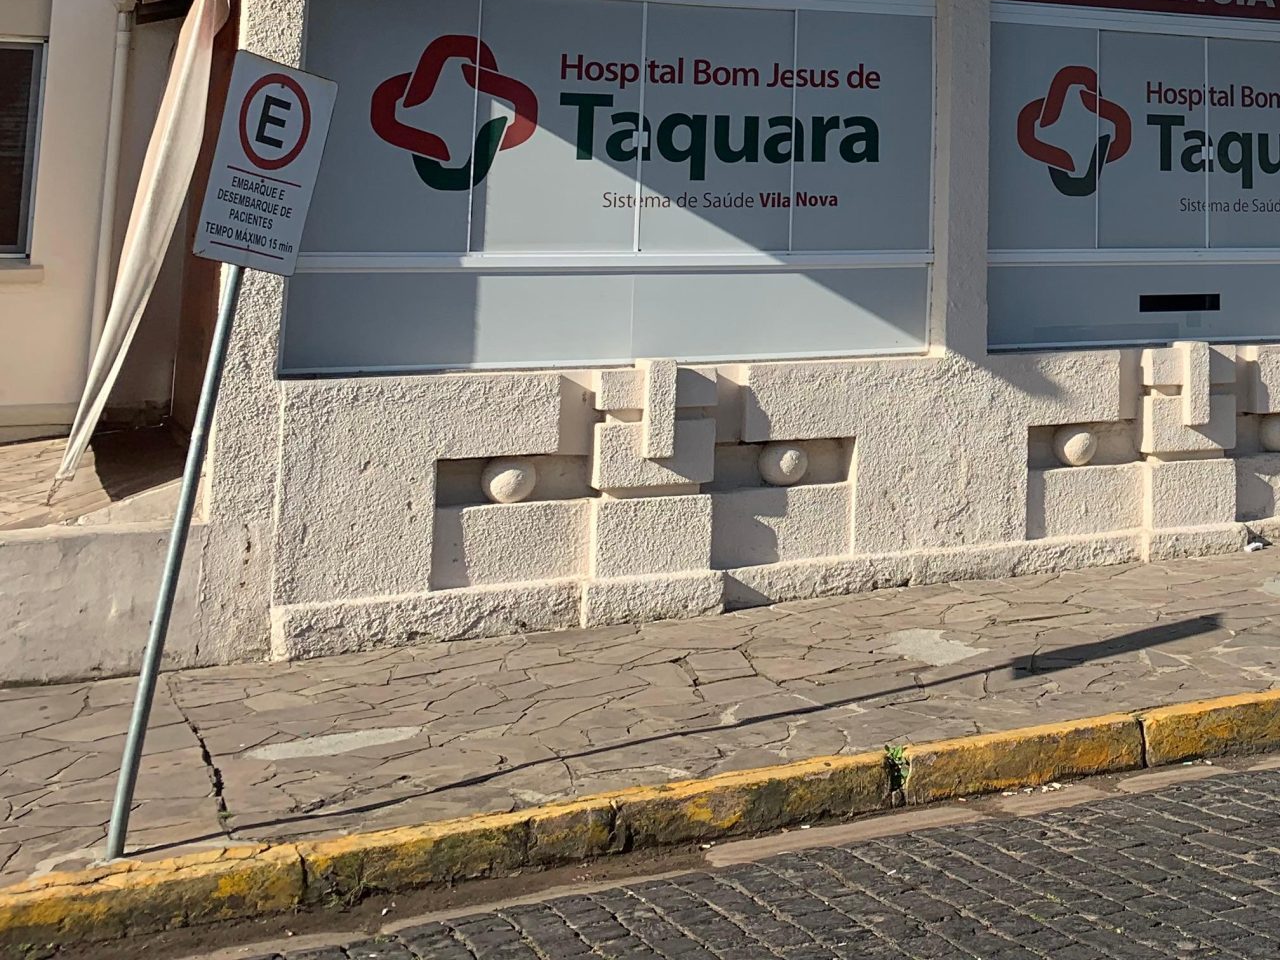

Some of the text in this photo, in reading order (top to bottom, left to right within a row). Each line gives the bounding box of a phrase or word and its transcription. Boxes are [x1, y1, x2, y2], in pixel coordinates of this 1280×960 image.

[693, 59, 760, 87] Bom
[766, 62, 839, 89] Jesus
[846, 63, 881, 89] de
[255, 94, 292, 149] E
[559, 92, 880, 181] Taquara
[217, 188, 293, 219] DESEMBARQUE DE
[231, 176, 286, 201] EMBARQUE E
[676, 192, 698, 208] de
[702, 192, 755, 209] Saúde
[759, 192, 791, 208] Vila
[796, 191, 838, 208] Nova
[228, 208, 274, 230] PACIENTES
[1233, 198, 1249, 212] de
[205, 221, 293, 253] TEMPO MÁXIMO 15 min
